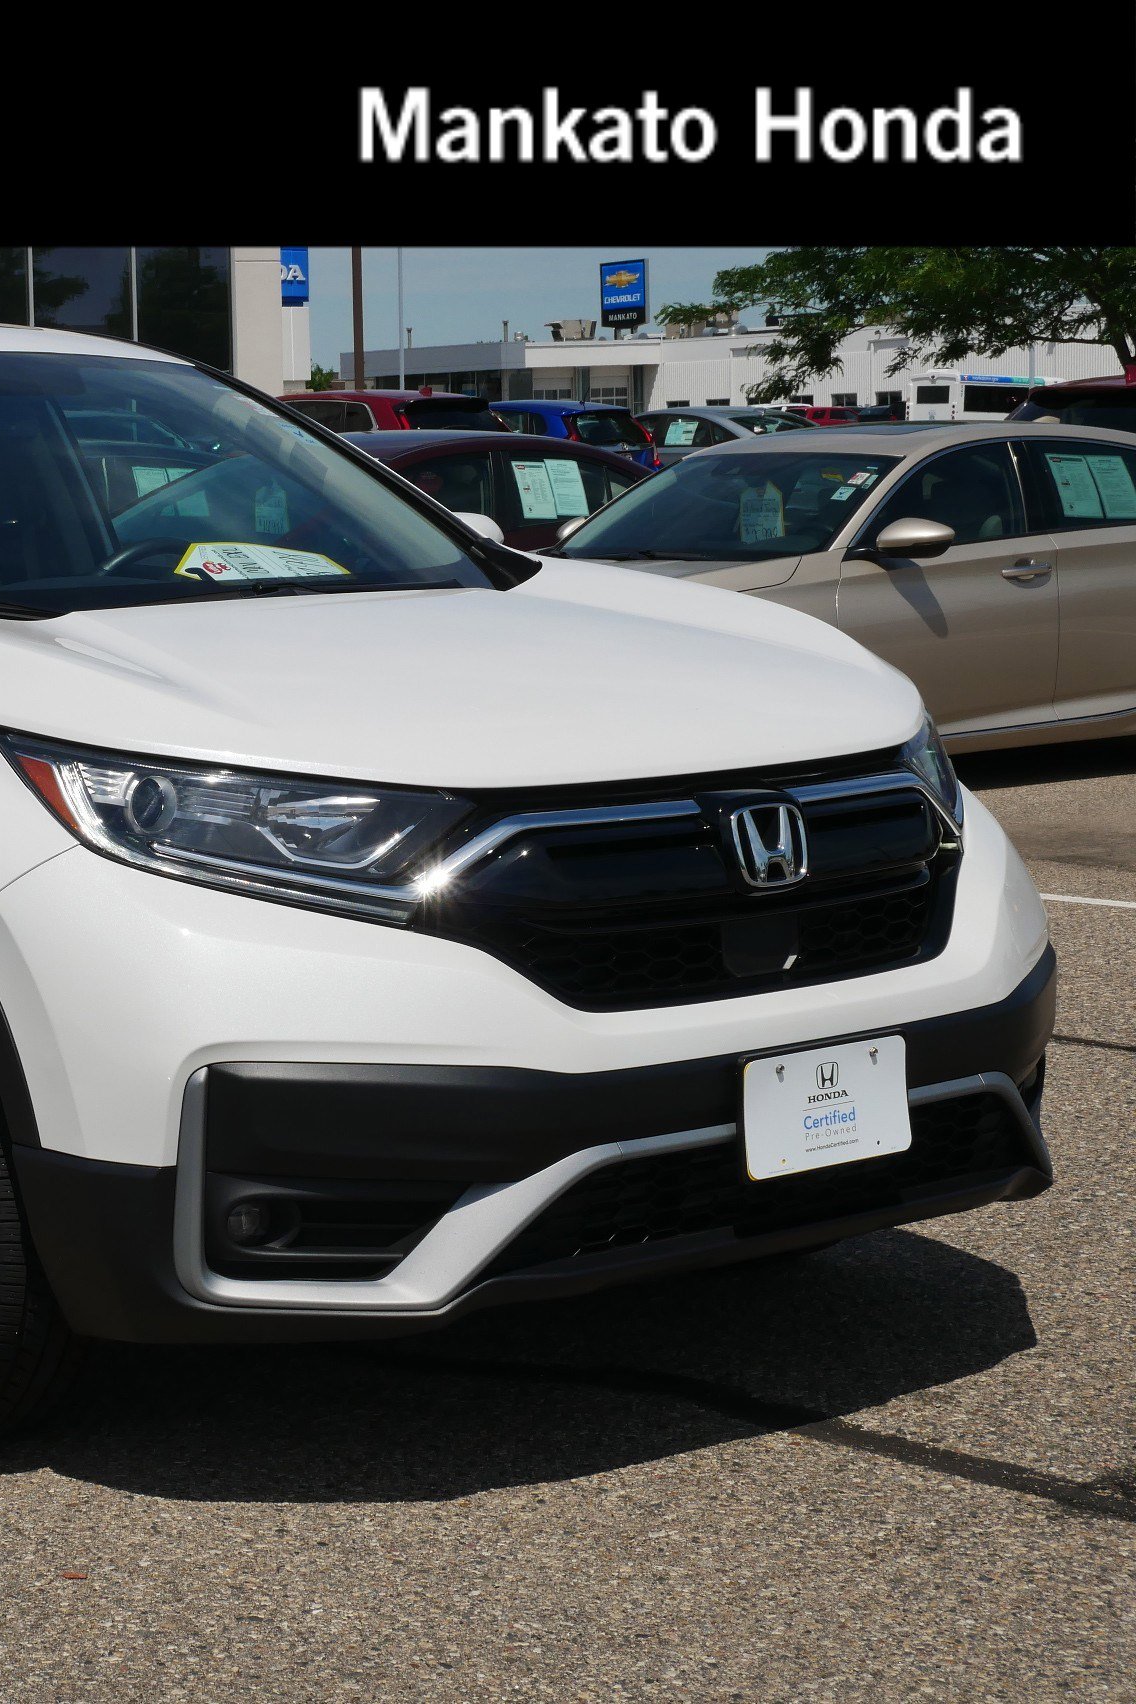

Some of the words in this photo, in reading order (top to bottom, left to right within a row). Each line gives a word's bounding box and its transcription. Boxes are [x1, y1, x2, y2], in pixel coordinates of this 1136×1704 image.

[604, 293, 641, 304] CHEVROLET
[608, 312, 638, 322] MANKATO
[807, 1089, 849, 1104] HONDA
[803, 1106, 856, 1130] Certified
[805, 1123, 857, 1142] Pre-Owned
